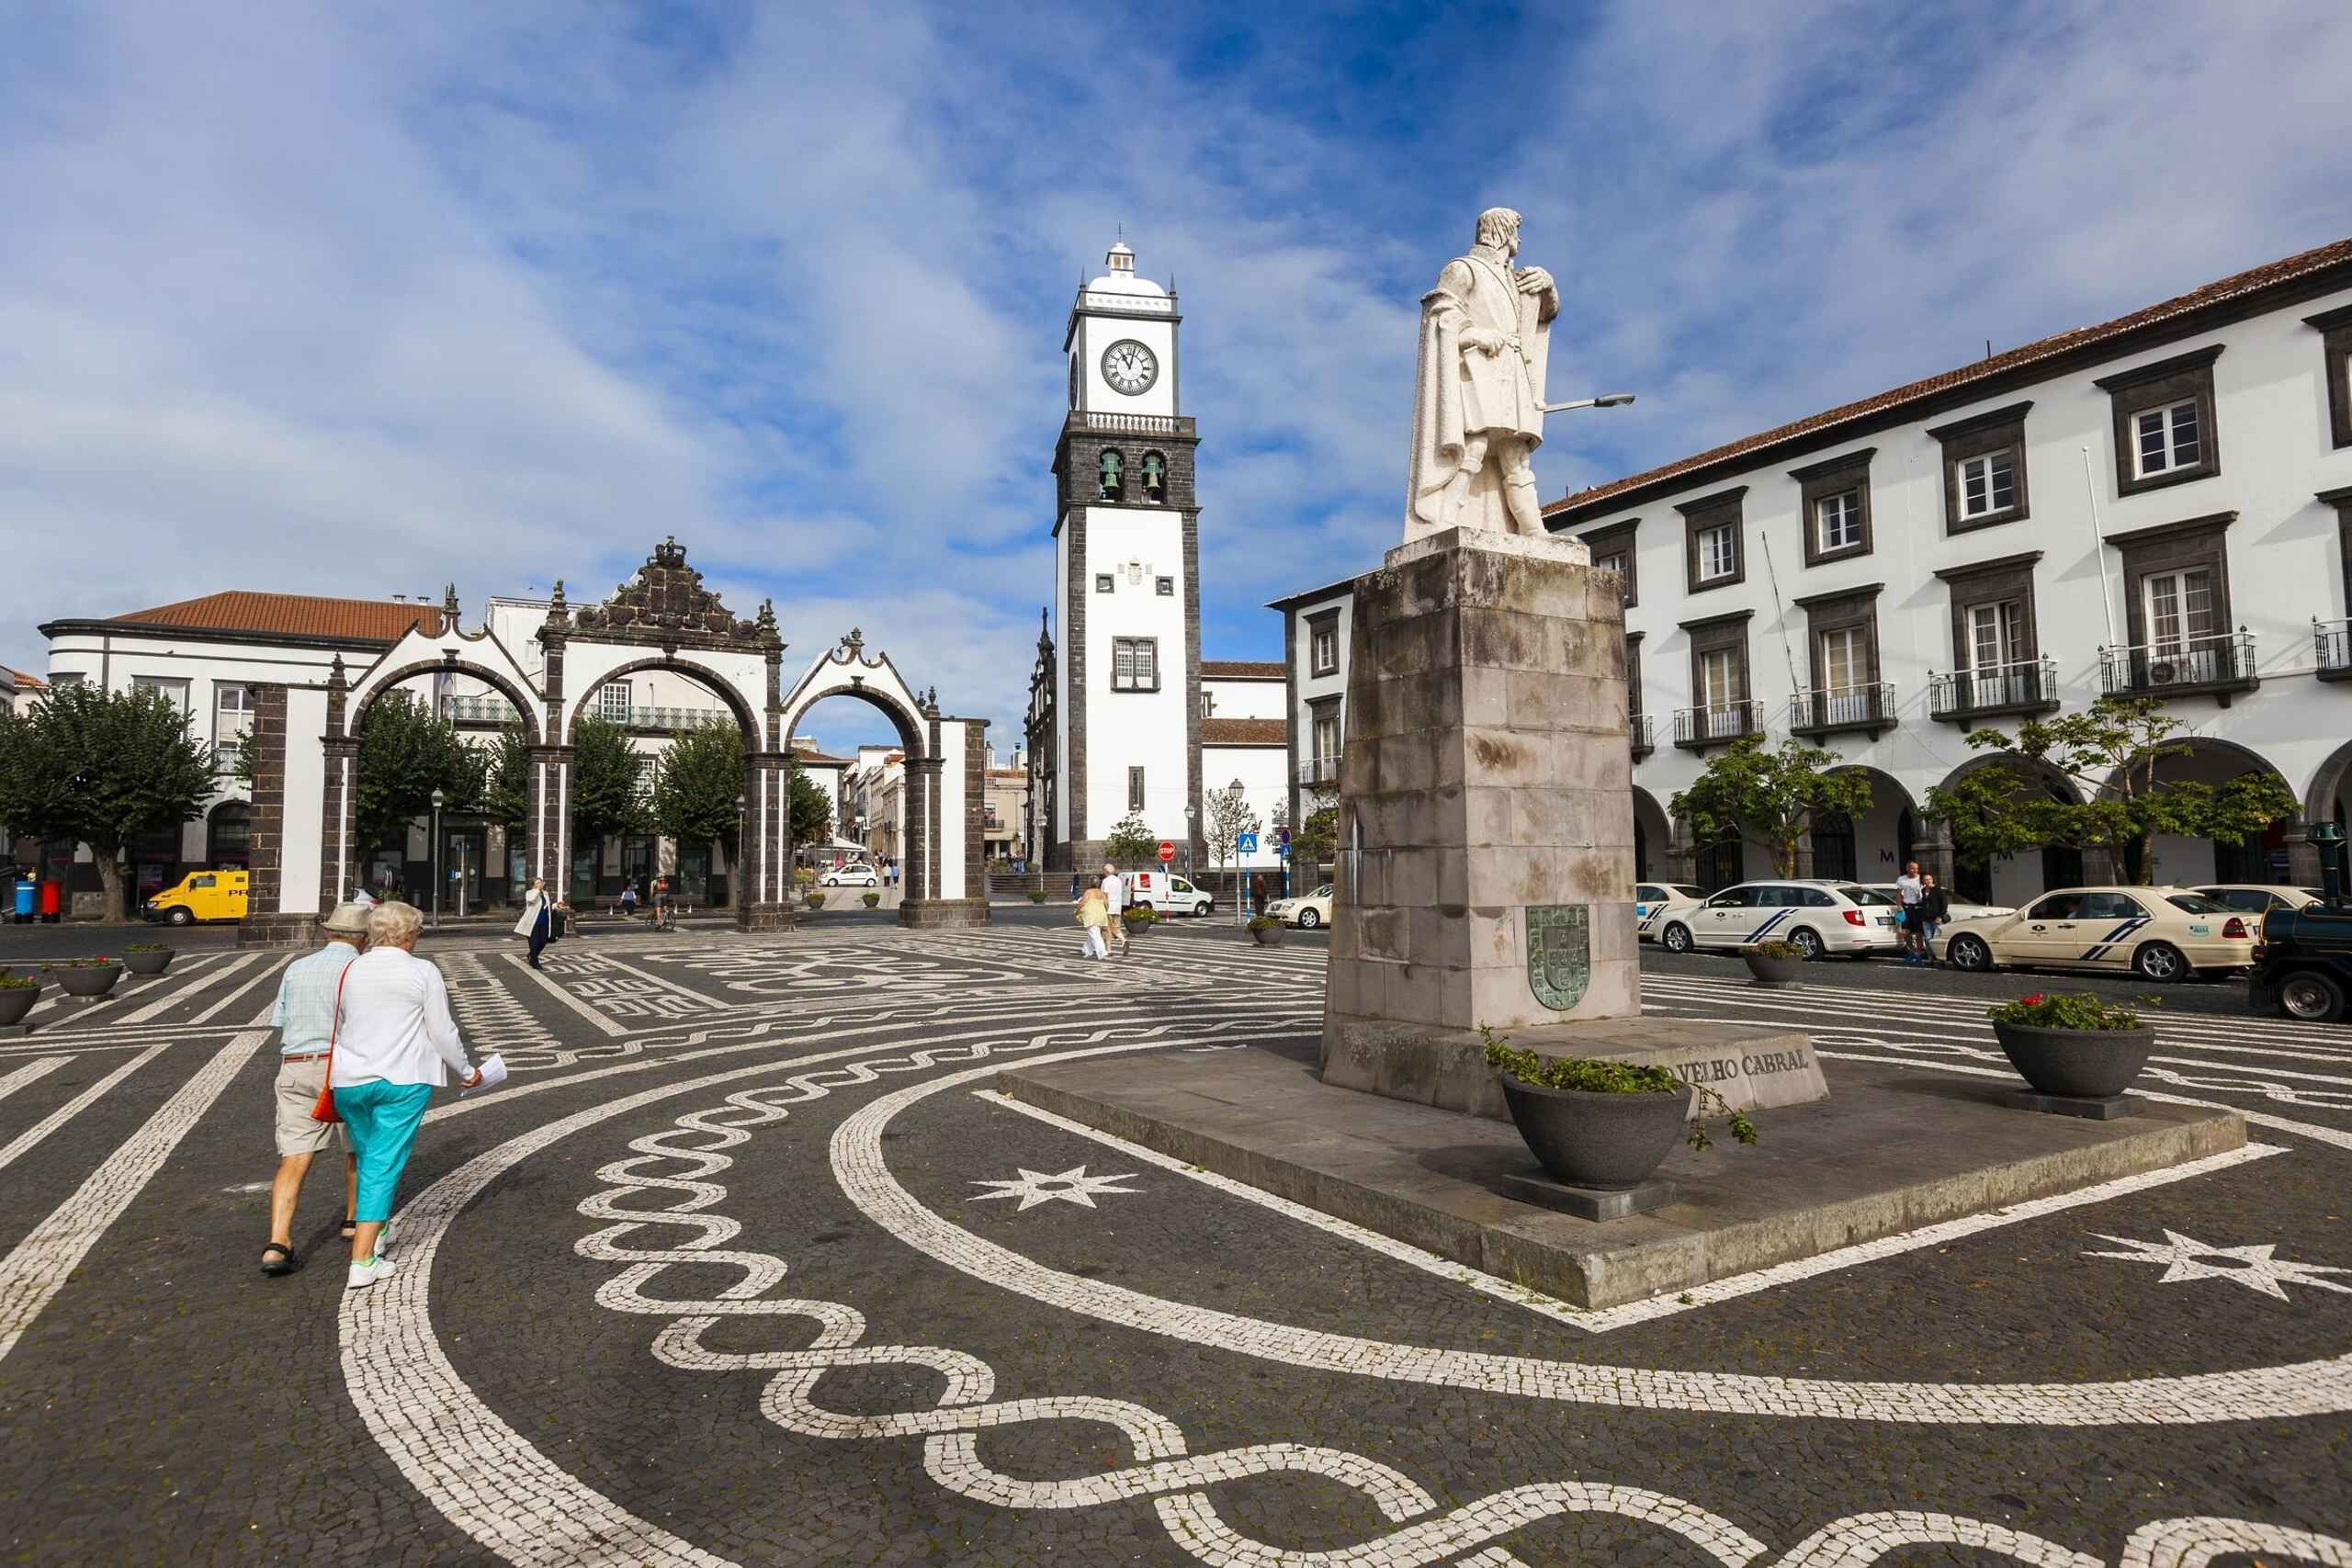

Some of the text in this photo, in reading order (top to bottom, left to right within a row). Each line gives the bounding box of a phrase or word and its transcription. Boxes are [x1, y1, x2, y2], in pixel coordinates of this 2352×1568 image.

[1881, 850, 1894, 863] M
[1677, 1059, 1737, 1082] VELHO
[1742, 1049, 1809, 1076] CABRAL
